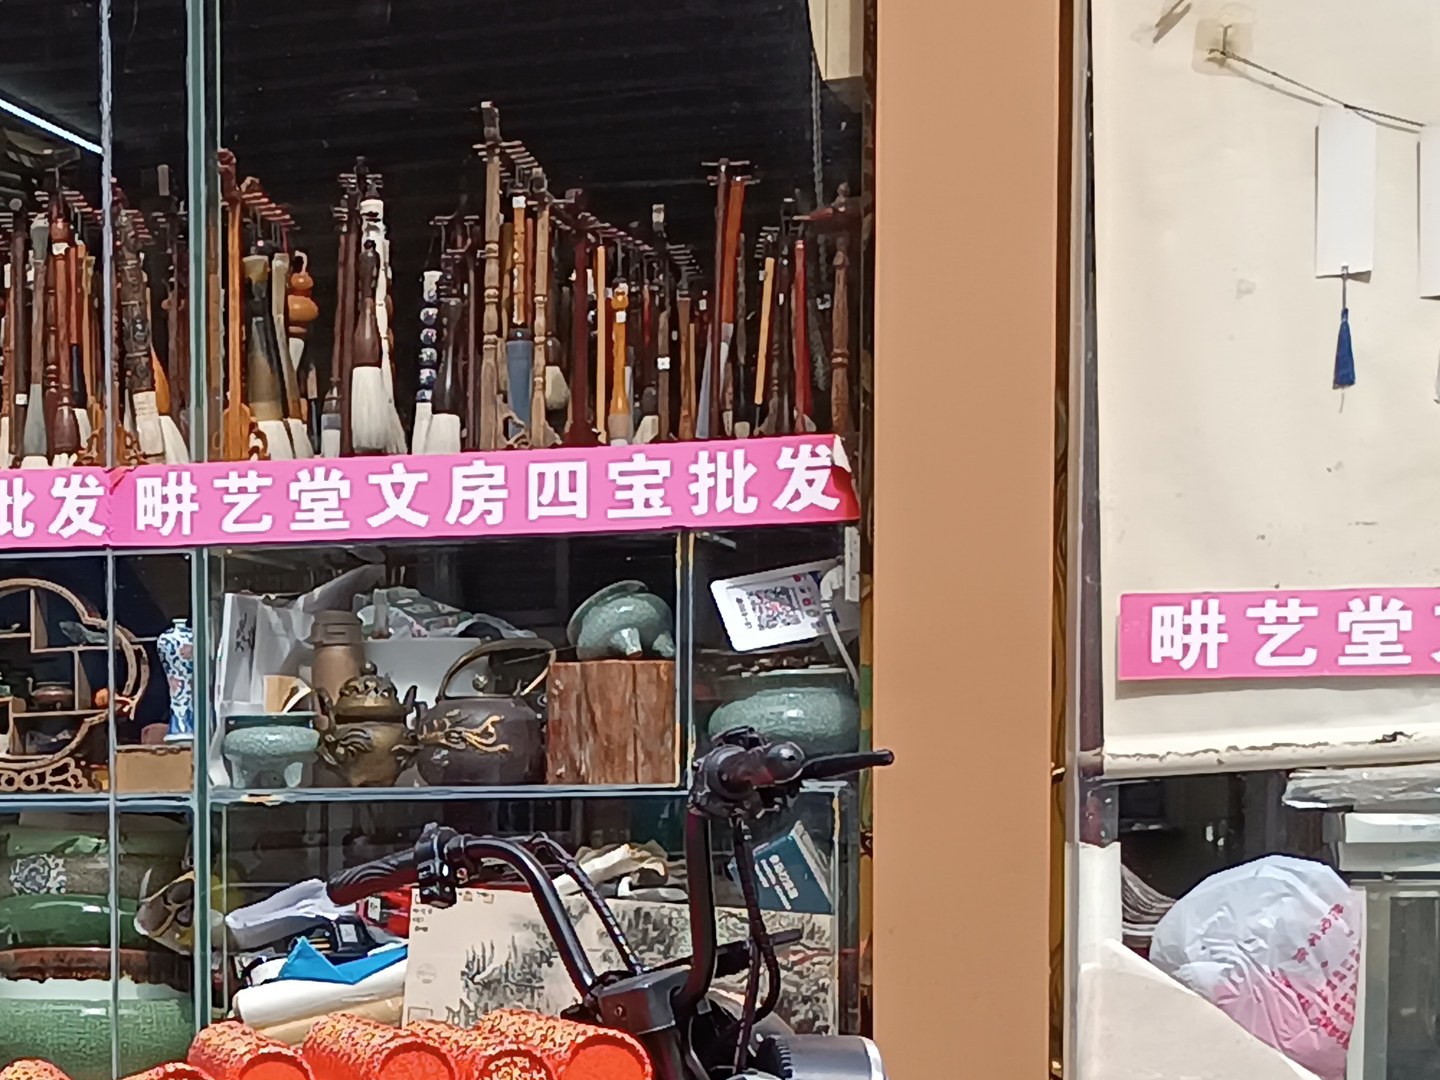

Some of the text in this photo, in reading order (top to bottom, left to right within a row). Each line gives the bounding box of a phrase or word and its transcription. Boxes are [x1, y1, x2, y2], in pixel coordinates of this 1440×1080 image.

[136, 444, 841, 536] 畊艺堂文房四宝批发
[1151, 595, 1440, 670] 畊艺堂
